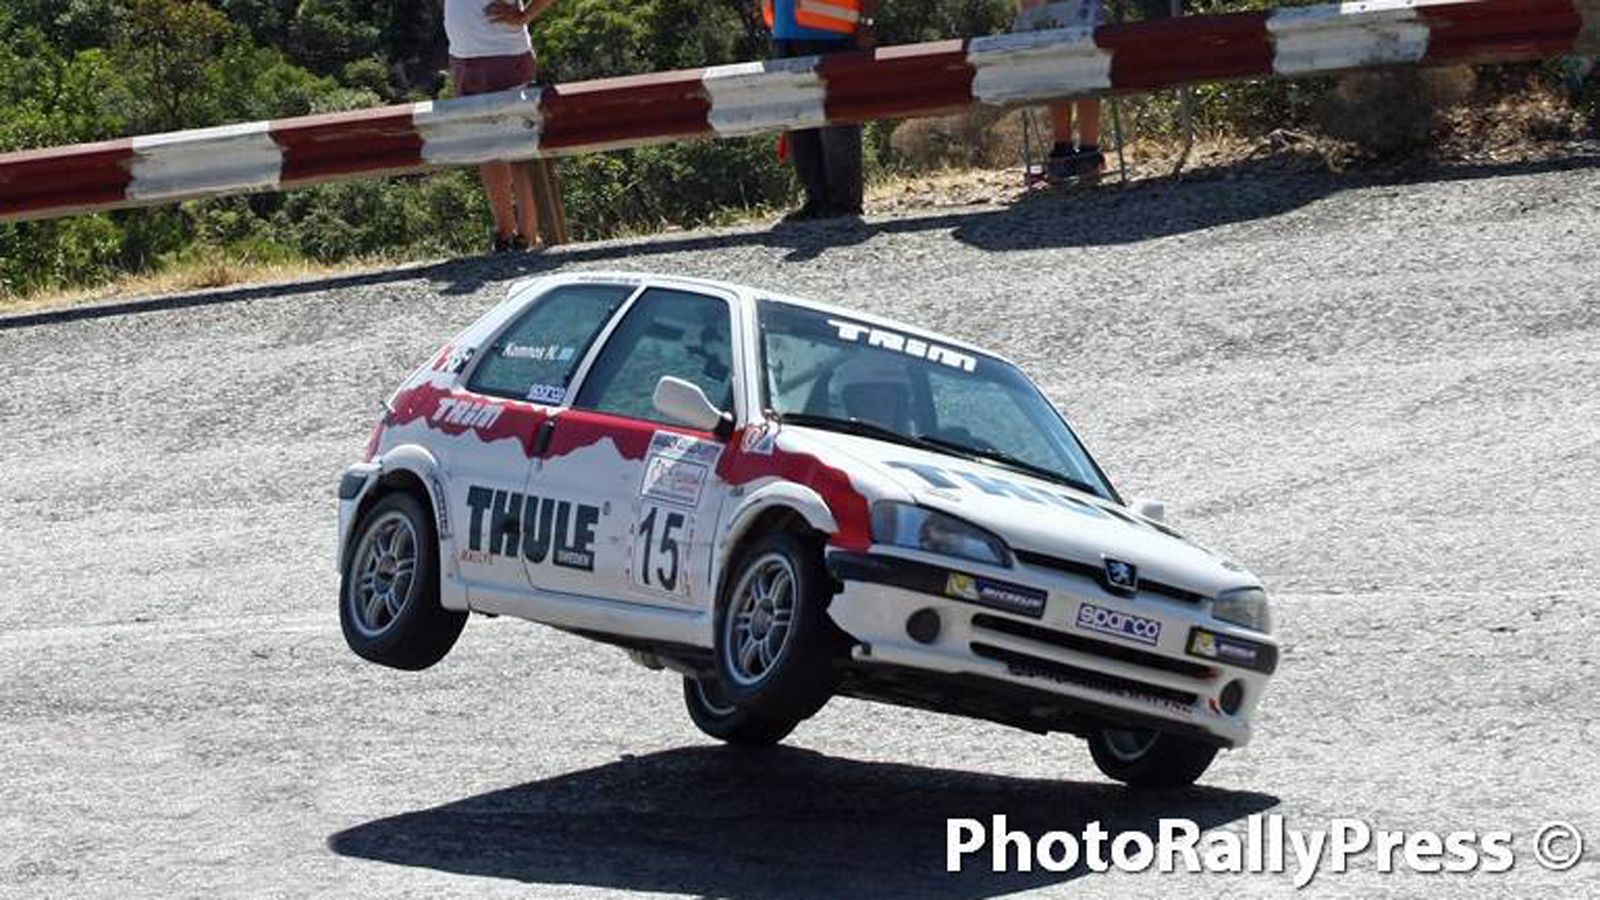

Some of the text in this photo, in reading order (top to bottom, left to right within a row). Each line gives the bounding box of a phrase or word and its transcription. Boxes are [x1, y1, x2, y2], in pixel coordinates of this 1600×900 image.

[827, 319, 977, 373] TRIM
[467, 485, 599, 564] THULE
[639, 507, 685, 591] 15
[1079, 604, 1160, 639] sparco
